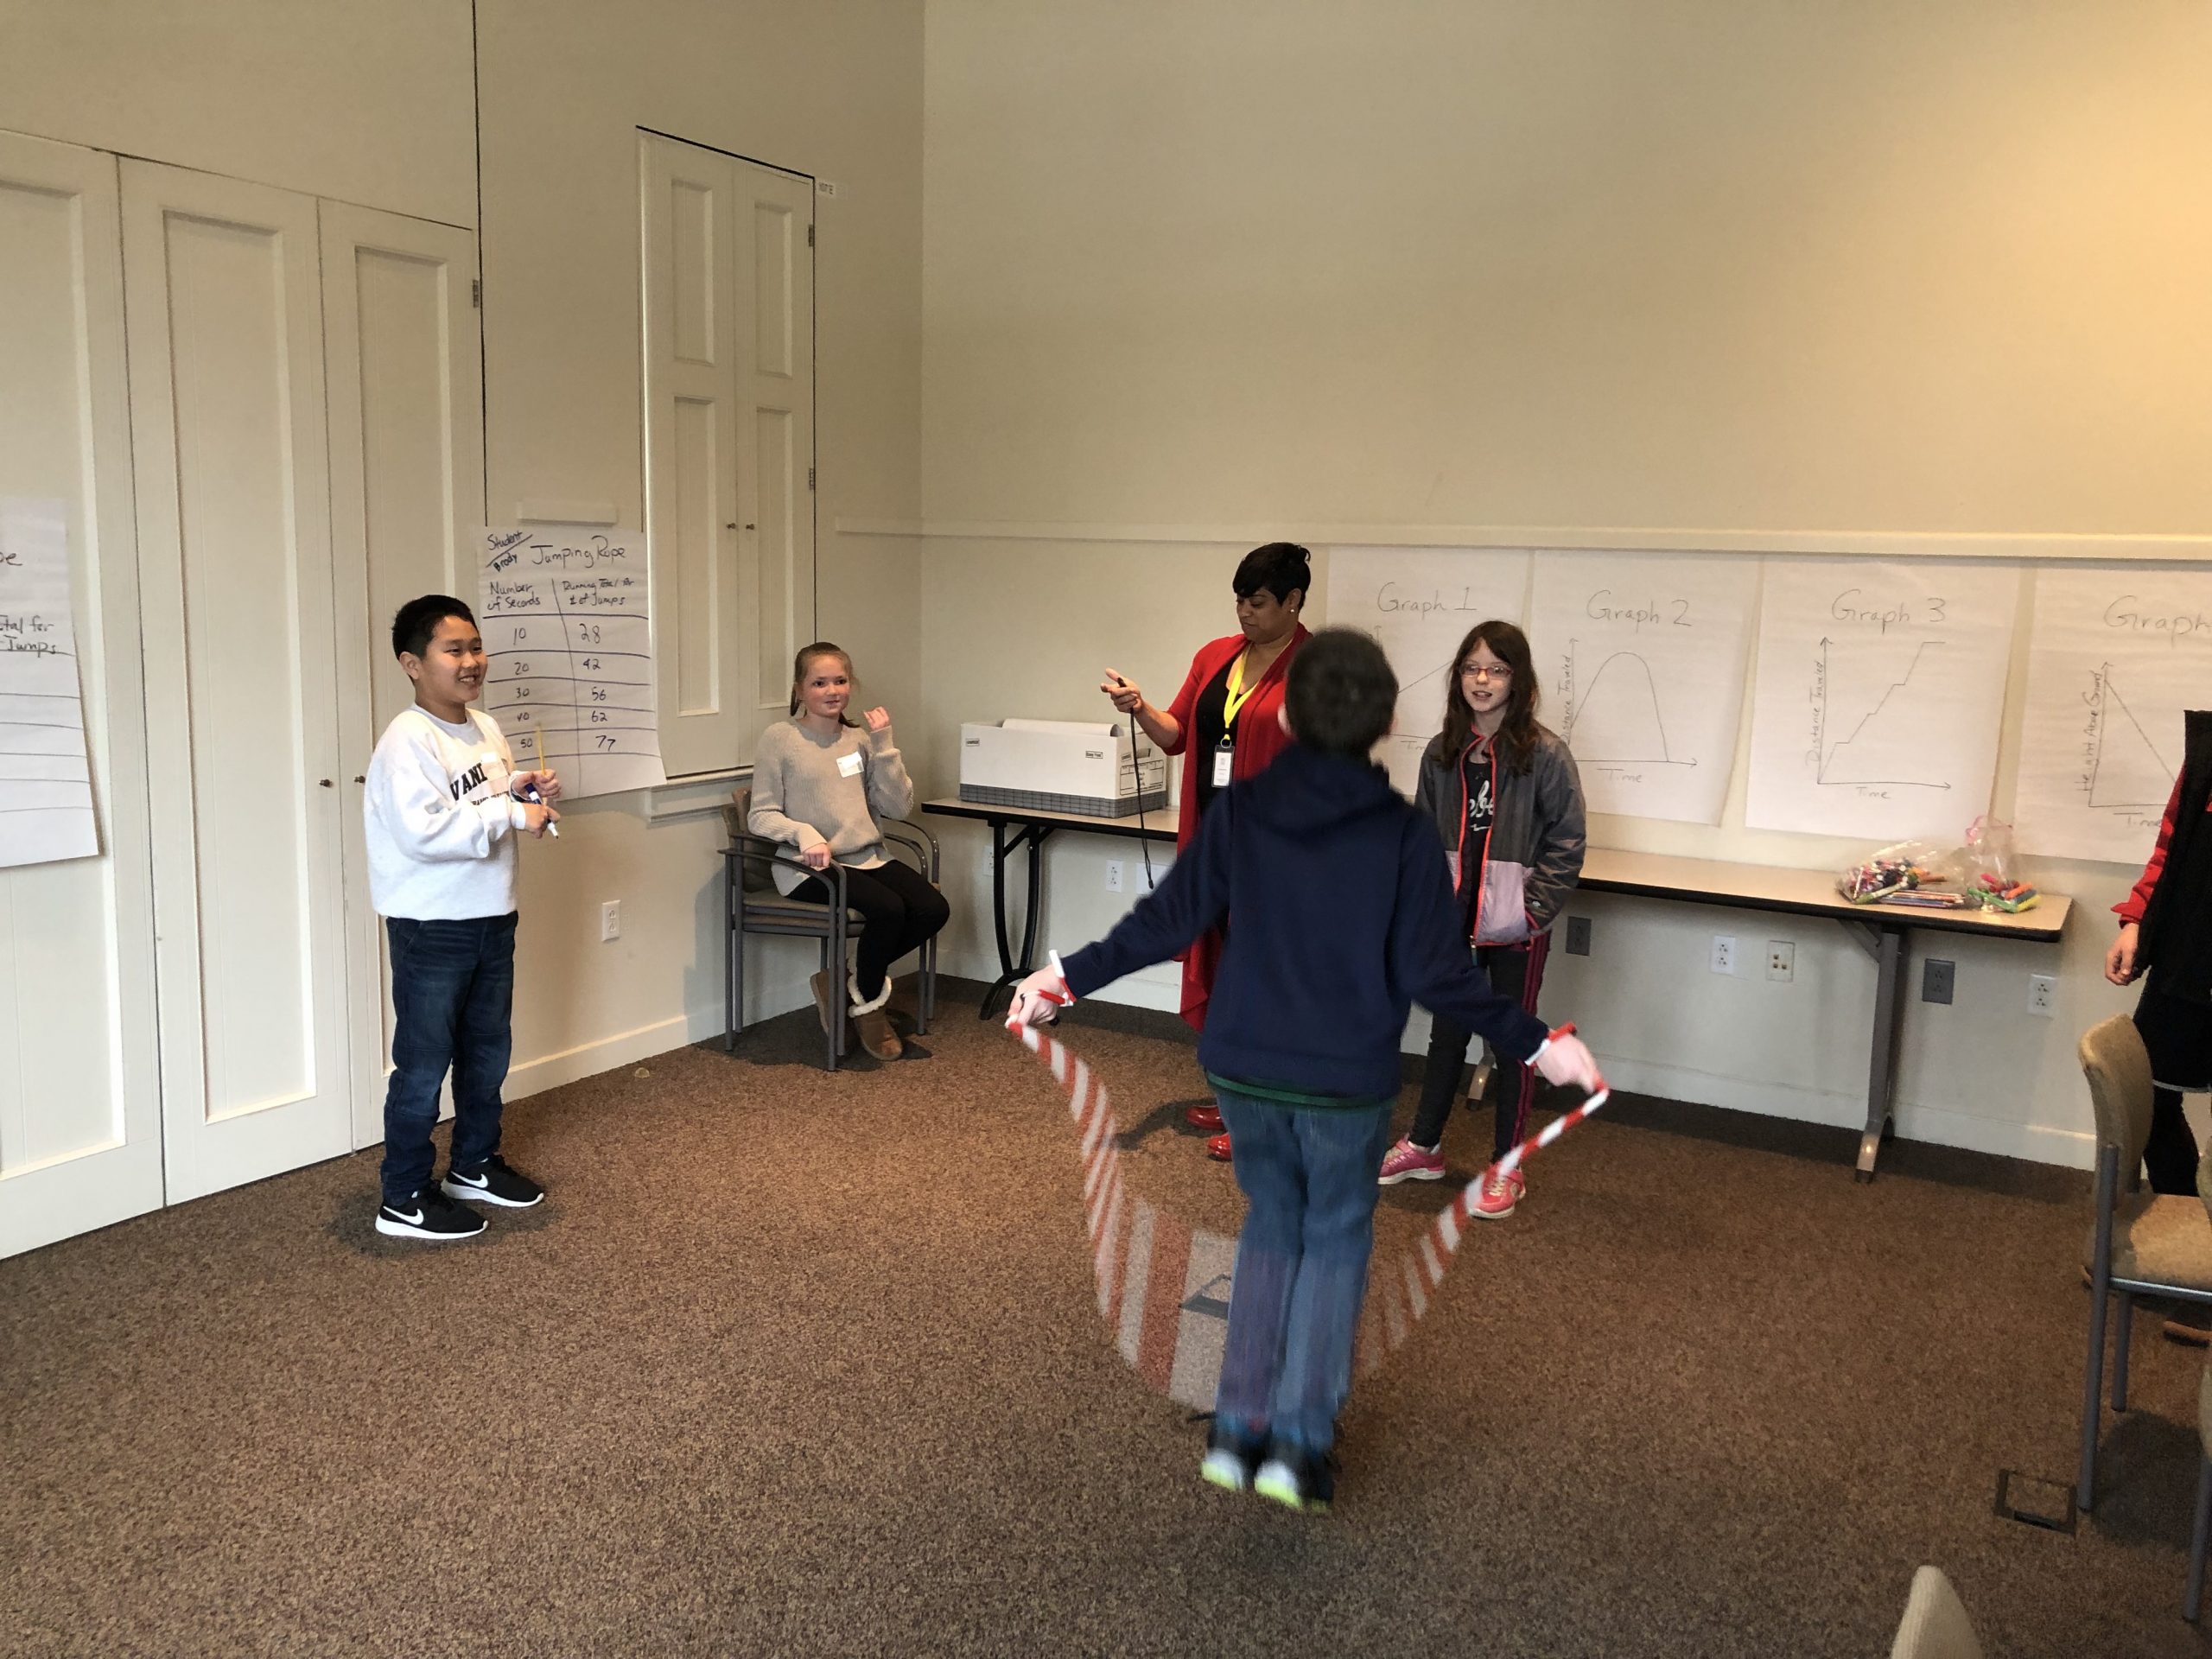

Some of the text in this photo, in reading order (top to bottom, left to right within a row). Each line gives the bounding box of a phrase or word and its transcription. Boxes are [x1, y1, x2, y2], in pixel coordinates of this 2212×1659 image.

[487, 531, 523, 550] Student
[530, 535, 626, 569] Jumping Rope
[493, 552, 518, 572] Brody
[490, 582, 533, 594] Number
[487, 591, 541, 612] of Seconds
[591, 592, 626, 607] Jumps
[1377, 582, 1478, 620] Graph 1
[1586, 589, 1692, 633] Graph 2
[1832, 588, 1946, 635] Graph 3
[29, 614, 54, 632] for
[513, 627, 526, 645] 10
[580, 623, 601, 644] 28
[3, 634, 56, 658] Jumps
[514, 662, 530, 675] 20
[582, 658, 601, 671] 42
[516, 688, 530, 698] 30
[591, 686, 607, 701] 56
[518, 712, 530, 721] 40
[591, 711, 607, 722] 62
[2083, 710, 2098, 737] Above
[520, 739, 532, 747] 50
[595, 735, 616, 751] 77
[1805, 707, 1821, 766] Distance
[1400, 741, 1426, 750] Tim
[1596, 768, 1642, 782] Time
[1856, 786, 1891, 799] Time
